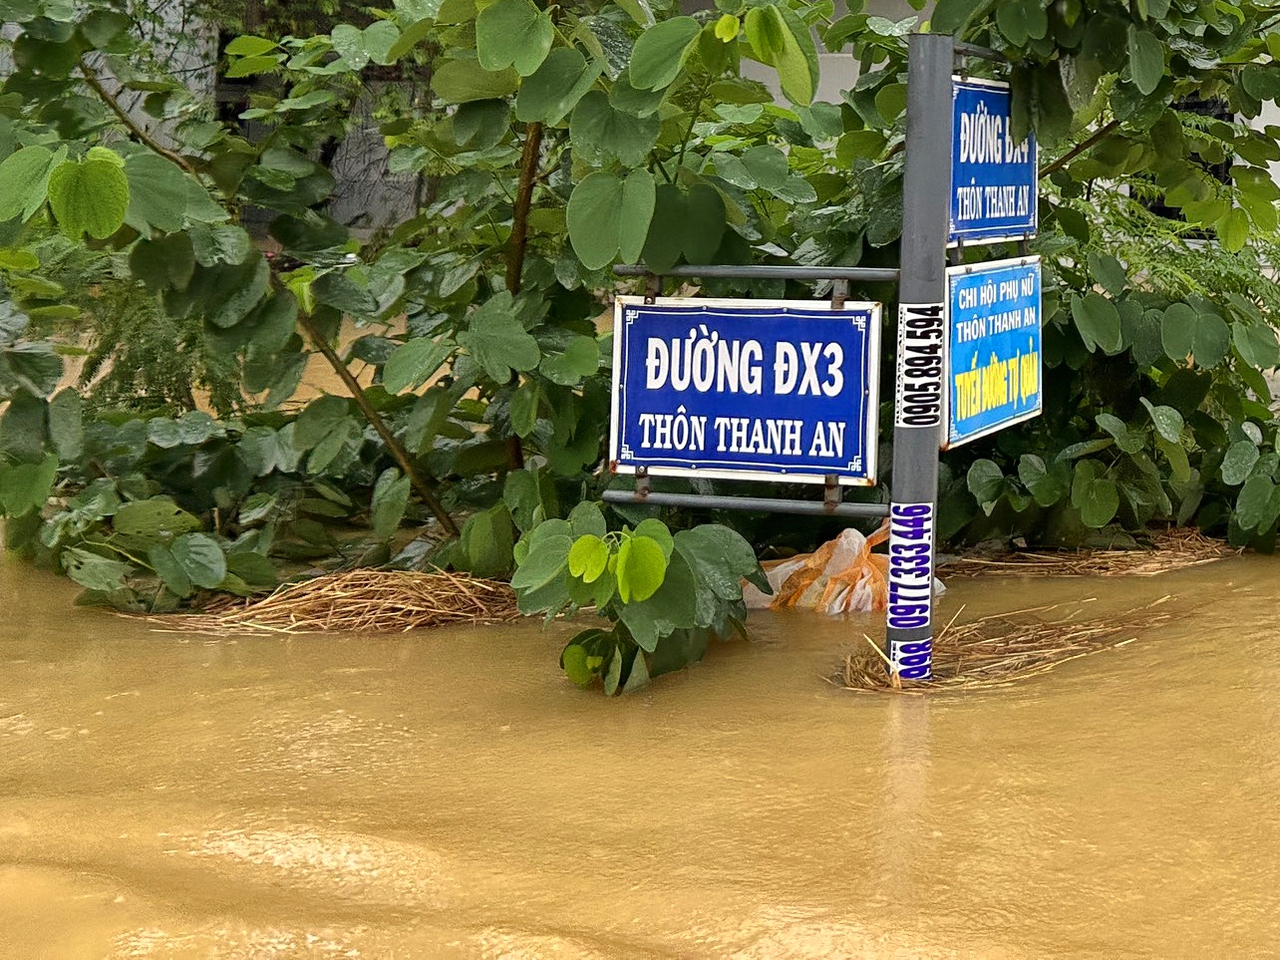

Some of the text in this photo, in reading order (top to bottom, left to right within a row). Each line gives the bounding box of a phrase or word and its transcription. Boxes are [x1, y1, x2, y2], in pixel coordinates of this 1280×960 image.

[960, 100, 1003, 164] ĐƯỜNG
[957, 177, 1029, 221] THÔN THANH AN
[958, 273, 1034, 310] CHI HỘI PHỤ NỮ
[956, 306, 1036, 344] THÔN THANH AN
[645, 324, 764, 396] ĐƯỜNG
[773, 342, 844, 398] ĐX3
[902, 306, 943, 426] 0905.894.594
[639, 405, 847, 459] THÔN THANH AN
[888, 505, 932, 628] 0977.333.446
